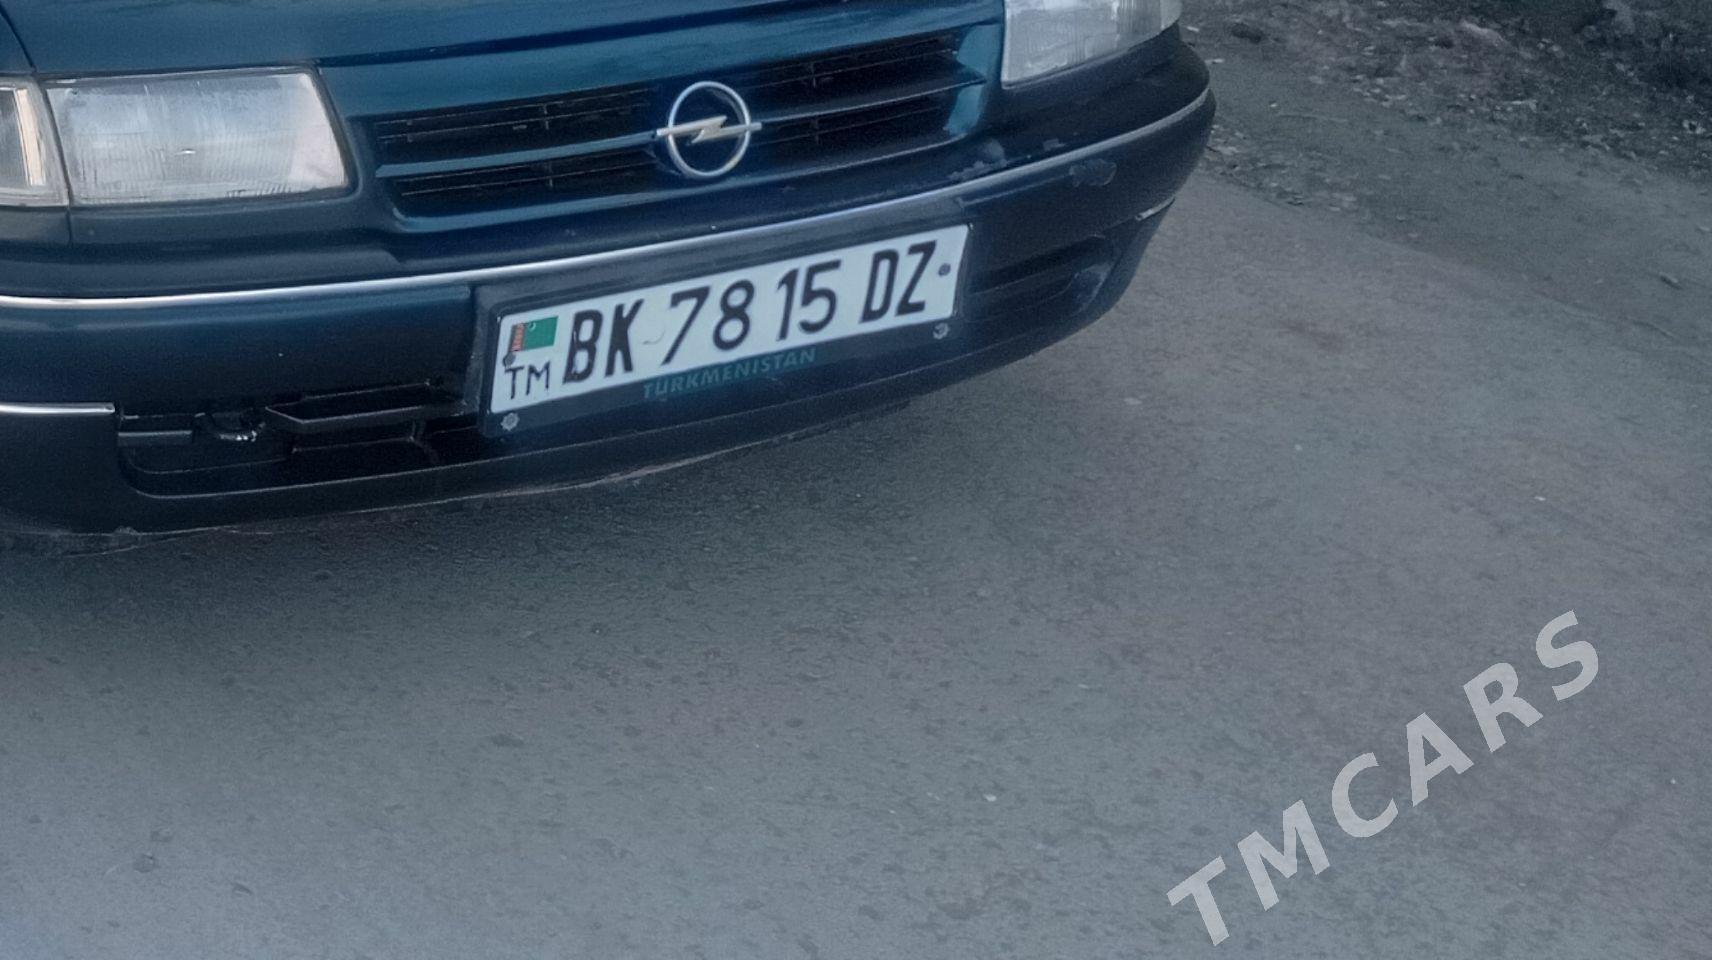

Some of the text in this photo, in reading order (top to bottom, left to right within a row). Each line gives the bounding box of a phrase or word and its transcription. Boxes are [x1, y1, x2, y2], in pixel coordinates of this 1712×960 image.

[563, 299, 644, 384] BK
[859, 241, 937, 324] DZ
[505, 361, 550, 399] TM
